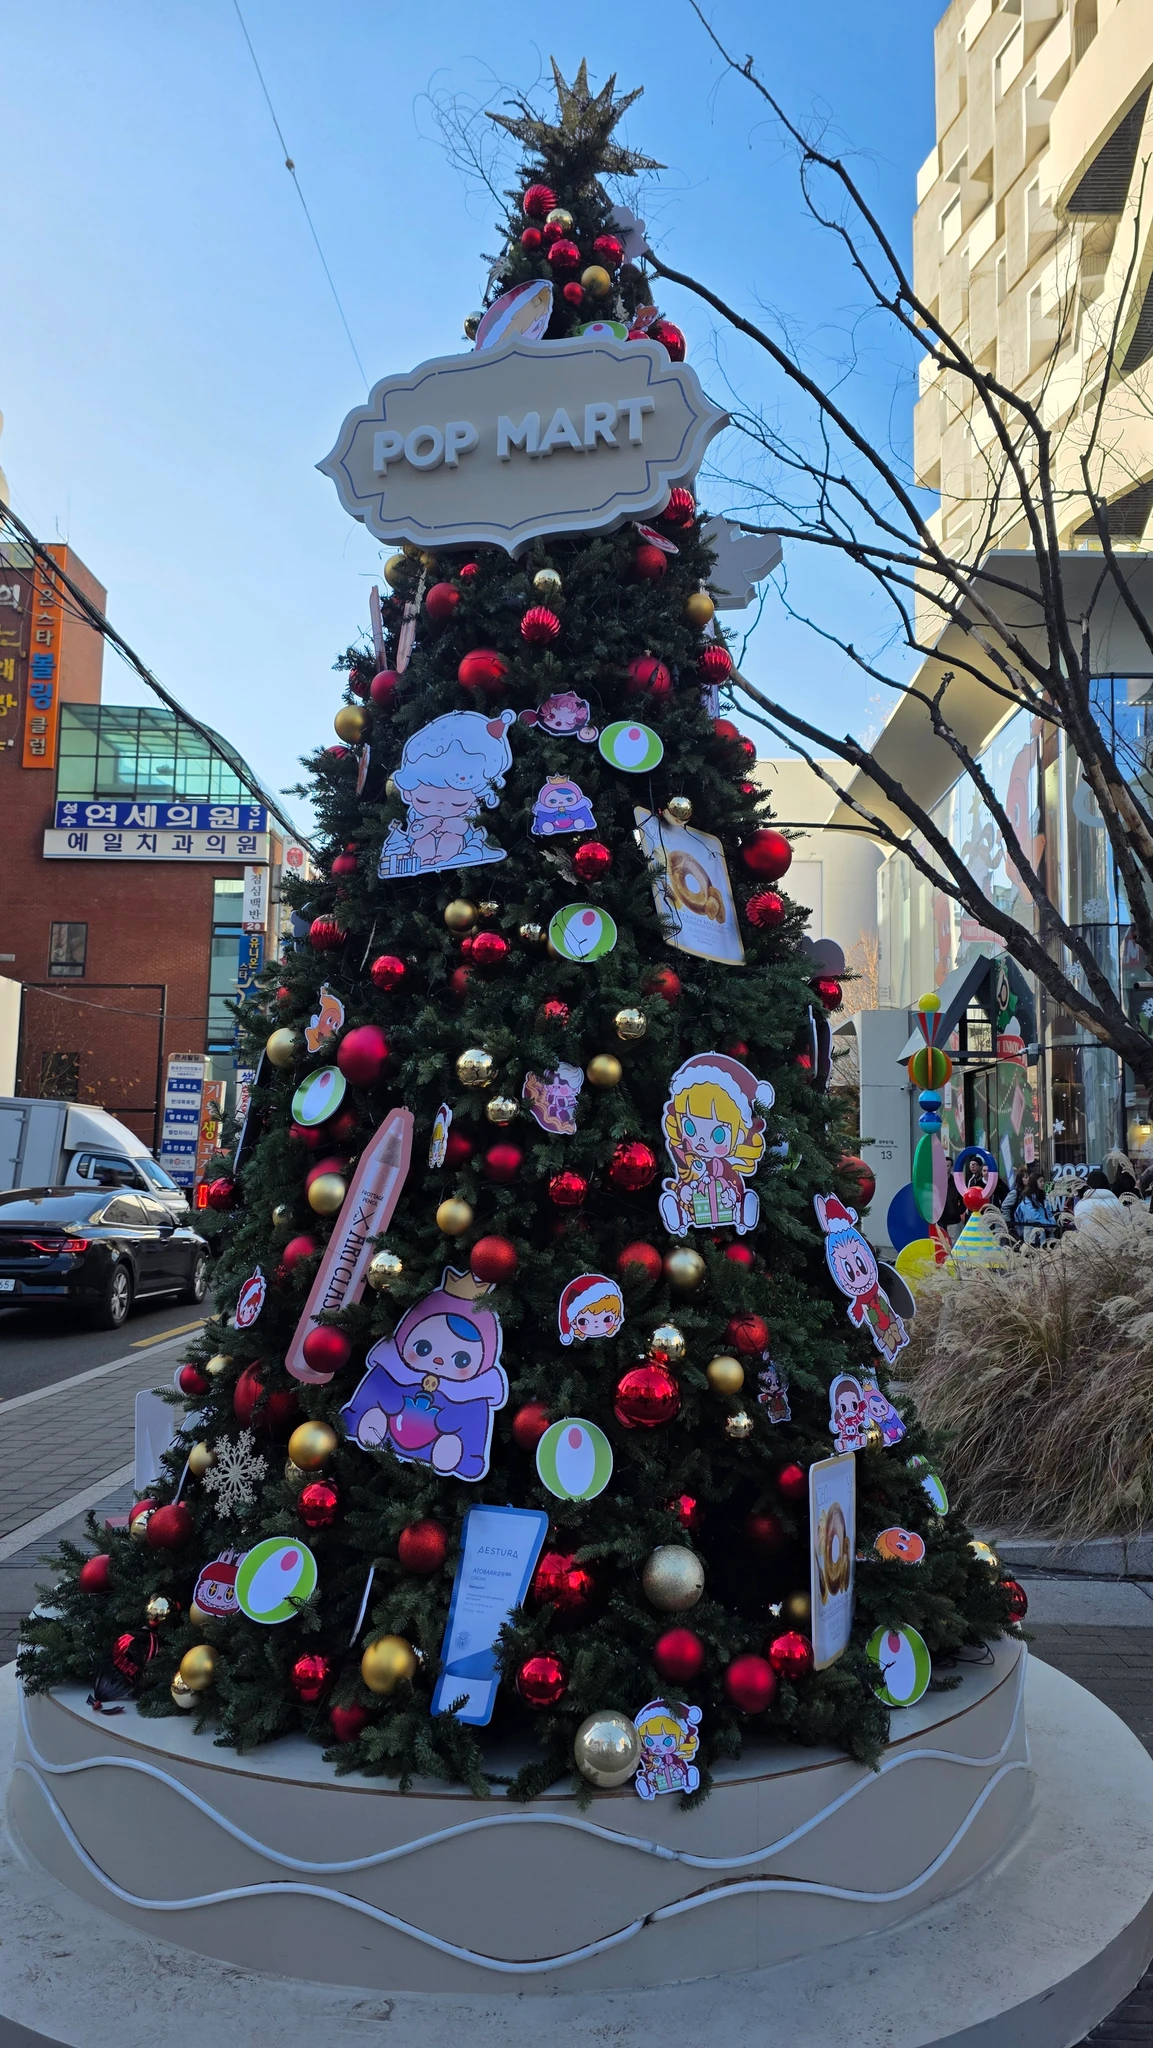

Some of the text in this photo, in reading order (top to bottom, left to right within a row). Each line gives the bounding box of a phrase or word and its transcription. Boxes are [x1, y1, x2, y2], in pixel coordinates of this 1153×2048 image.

[373, 396, 655, 476] POP MART
[29, 652, 57, 710] 볼링
[30, 716, 48, 756] 클럽
[61, 803, 78, 827] 성수
[85, 804, 240, 829] 연세의원
[67, 832, 258, 855] 예일치과의원
[249, 873, 262, 920] 점심백반
[881, 1150, 893, 1160] 13
[319, 1230, 366, 1314] ART CLAS
[477, 1546, 519, 1559] AESTURA
